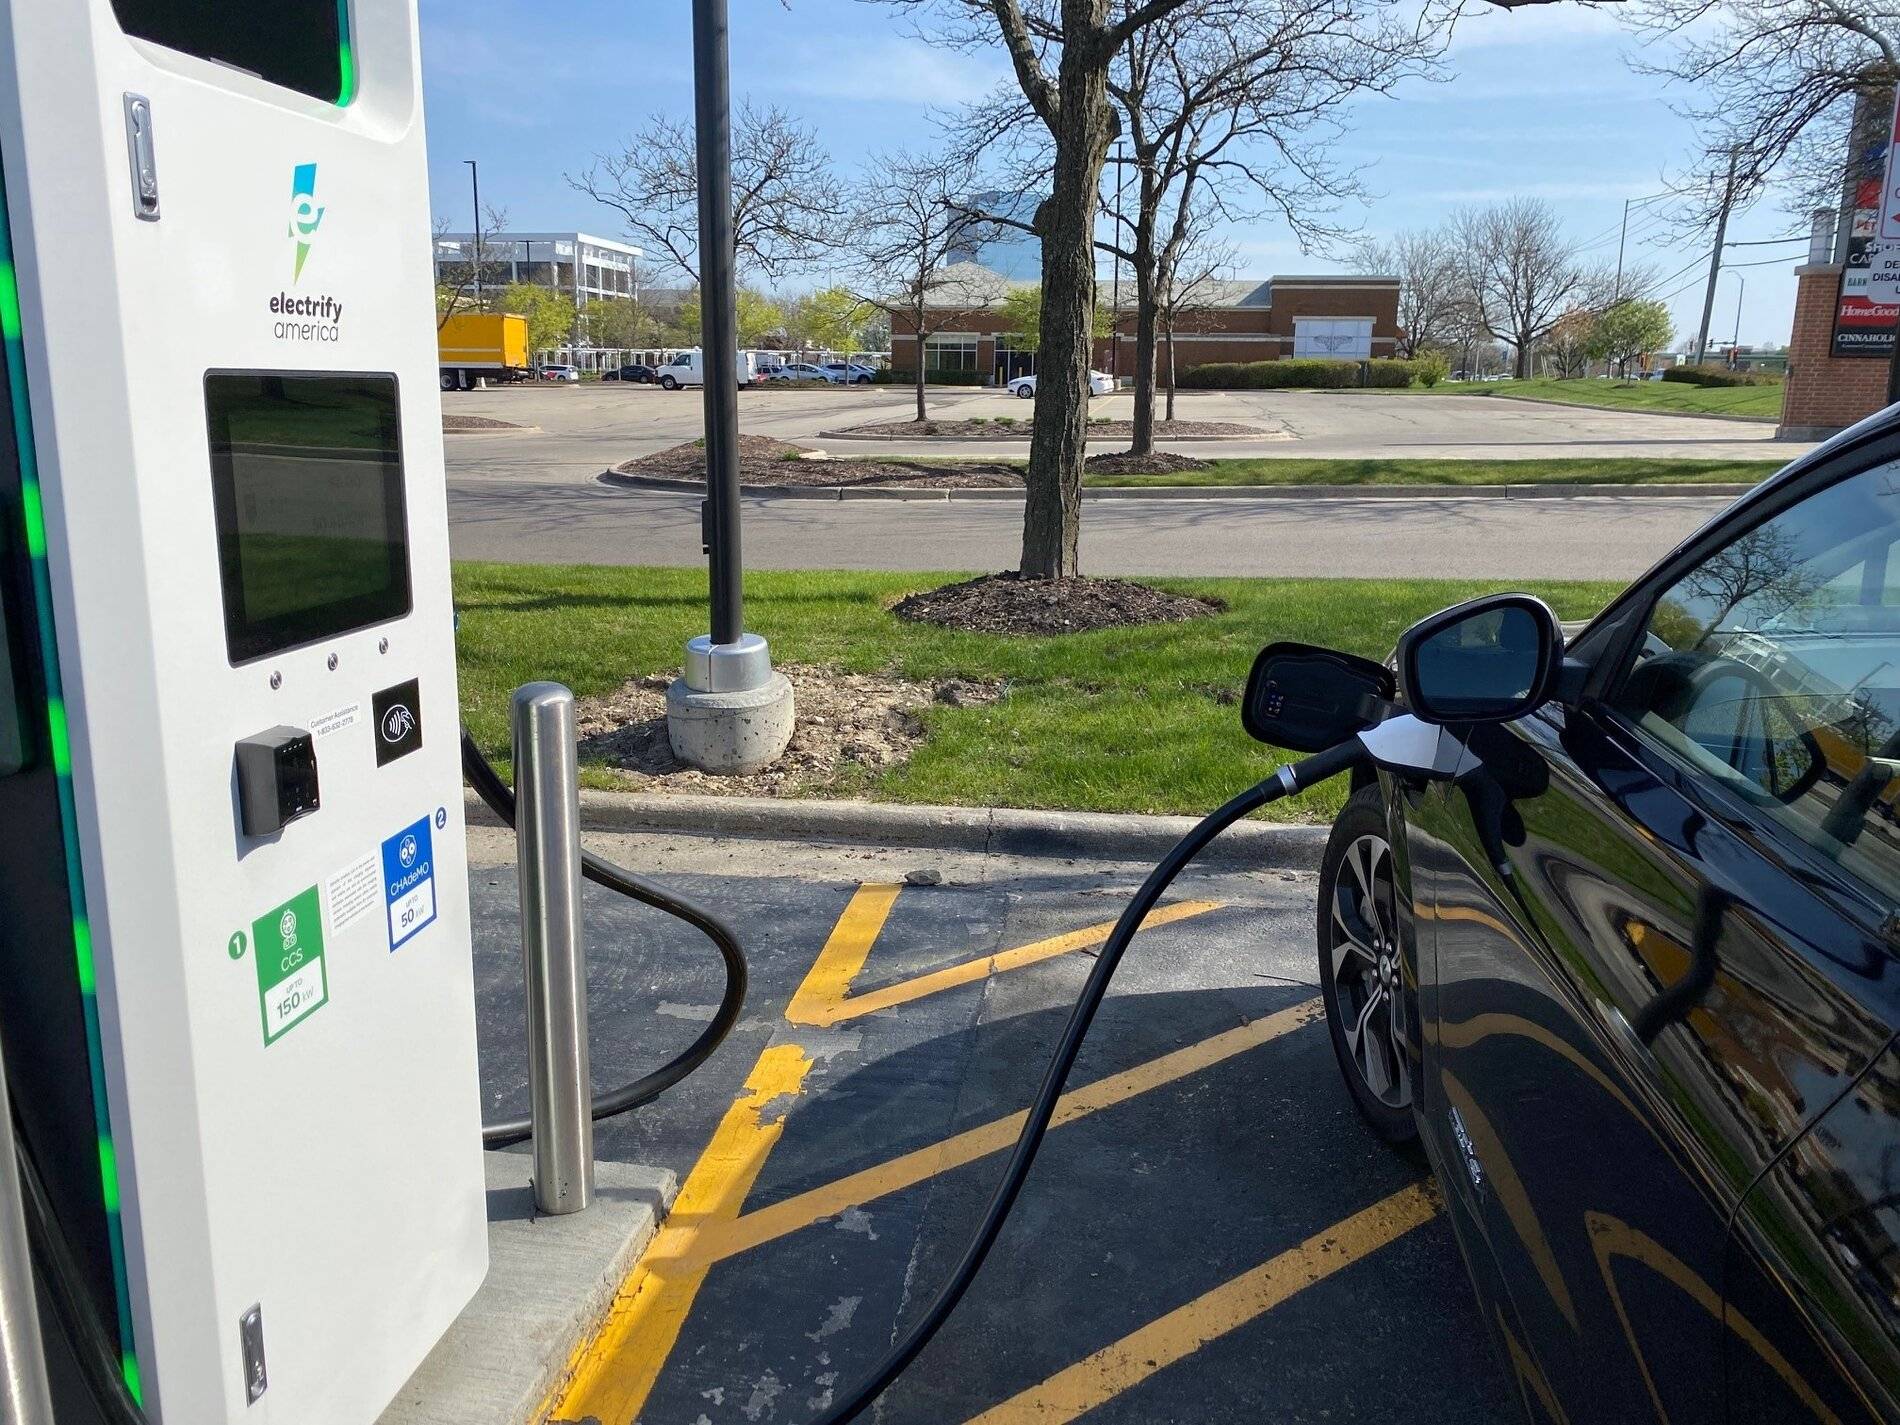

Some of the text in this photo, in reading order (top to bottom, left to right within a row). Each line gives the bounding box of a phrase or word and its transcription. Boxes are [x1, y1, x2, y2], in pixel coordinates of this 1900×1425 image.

[1873, 272, 1900, 281] DISA
[269, 292, 342, 323] electrify
[274, 320, 339, 342] america
[390, 861, 430, 896] CHAdeMO
[401, 908, 415, 928] 50
[281, 948, 303, 972] CCS
[276, 986, 314, 1019] 150 kW
